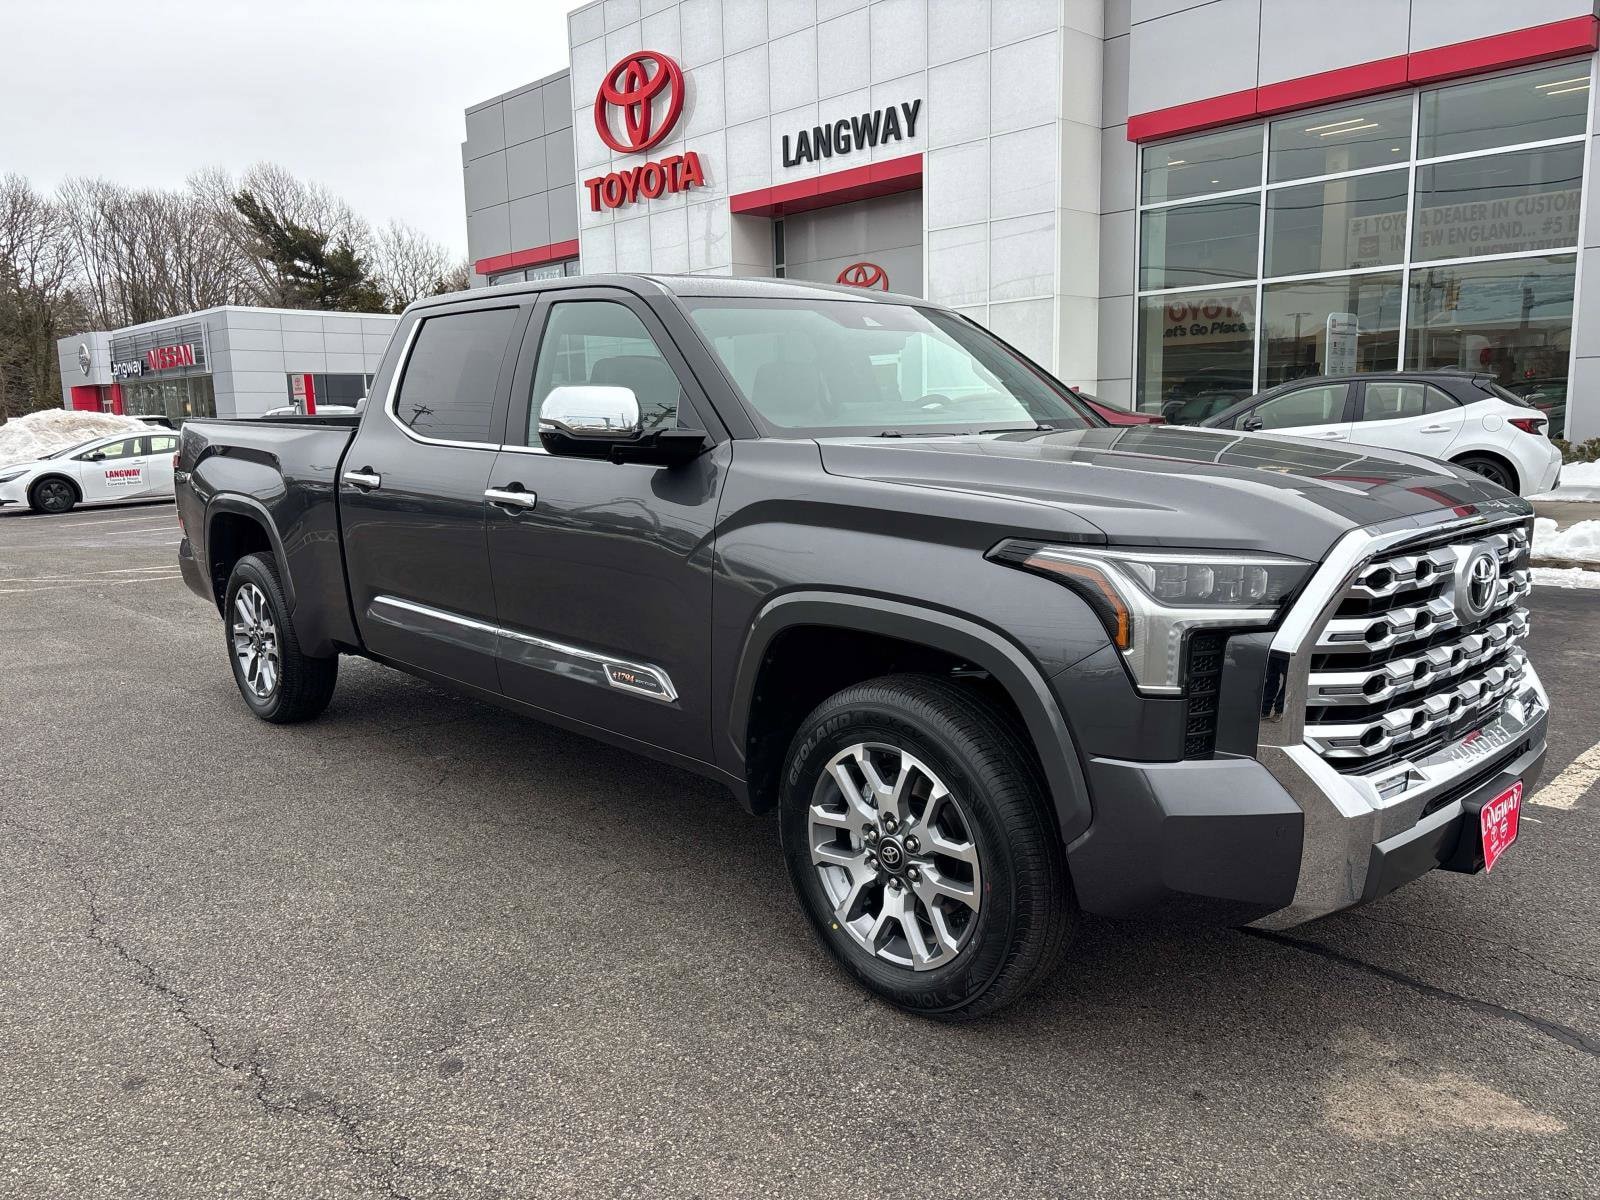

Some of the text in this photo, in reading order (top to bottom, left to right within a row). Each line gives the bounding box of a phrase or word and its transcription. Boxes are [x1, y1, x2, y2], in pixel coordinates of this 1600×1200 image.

[782, 98, 922, 168] LANGWAY
[585, 151, 705, 212] TOYOTA
[1375, 210, 1428, 233] TOYOA
[1433, 204, 1486, 225] DEALER
[1492, 201, 1510, 219] IN
[1448, 220, 1536, 245] ENGLAND...
[1168, 296, 1256, 322] OYOTA
[1190, 323, 1208, 336] Go
[110, 343, 197, 378] Langway NISSAN
[105, 469, 141, 478] LANGWAY
[1482, 789, 1520, 836] LANGWAY
